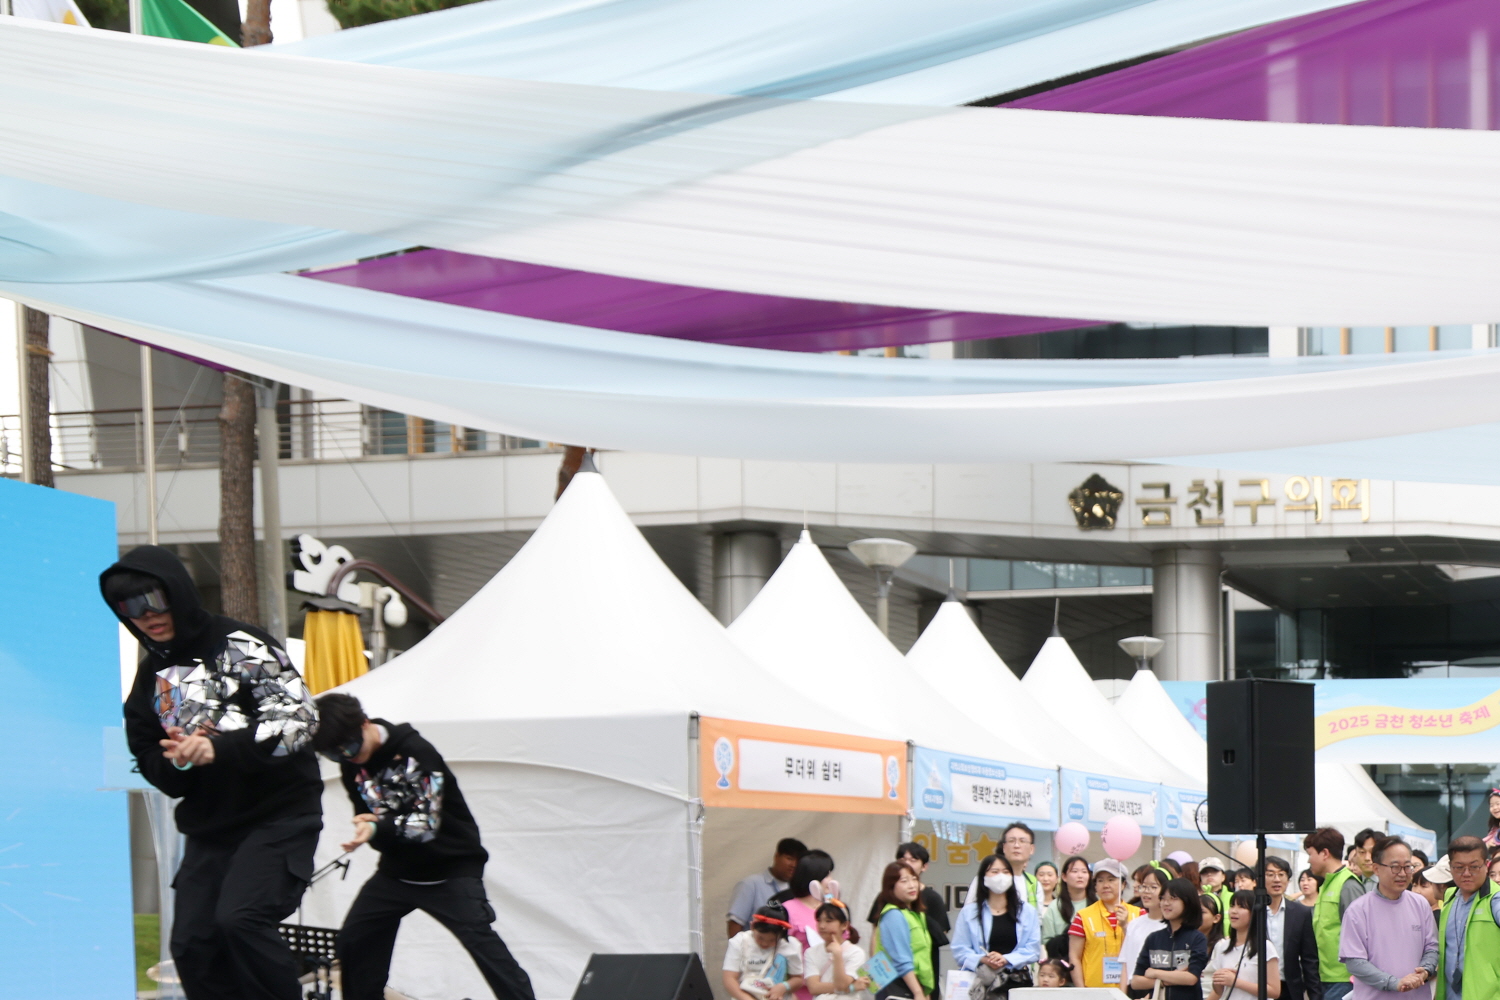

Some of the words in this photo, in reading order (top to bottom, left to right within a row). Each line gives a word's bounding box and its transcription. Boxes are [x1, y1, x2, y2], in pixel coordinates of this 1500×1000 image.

[1135, 474, 1370, 527] 금천구의회
[1328, 713, 1370, 735] 2025
[1374, 714, 1405, 729] 금천
[1409, 710, 1454, 730] 청소년
[1458, 705, 1491, 726] 축제
[785, 756, 816, 780] 무더위
[820, 760, 842, 783] 쉼터
[971, 784, 992, 803] 행복한
[993, 786, 1007, 806] 순간
